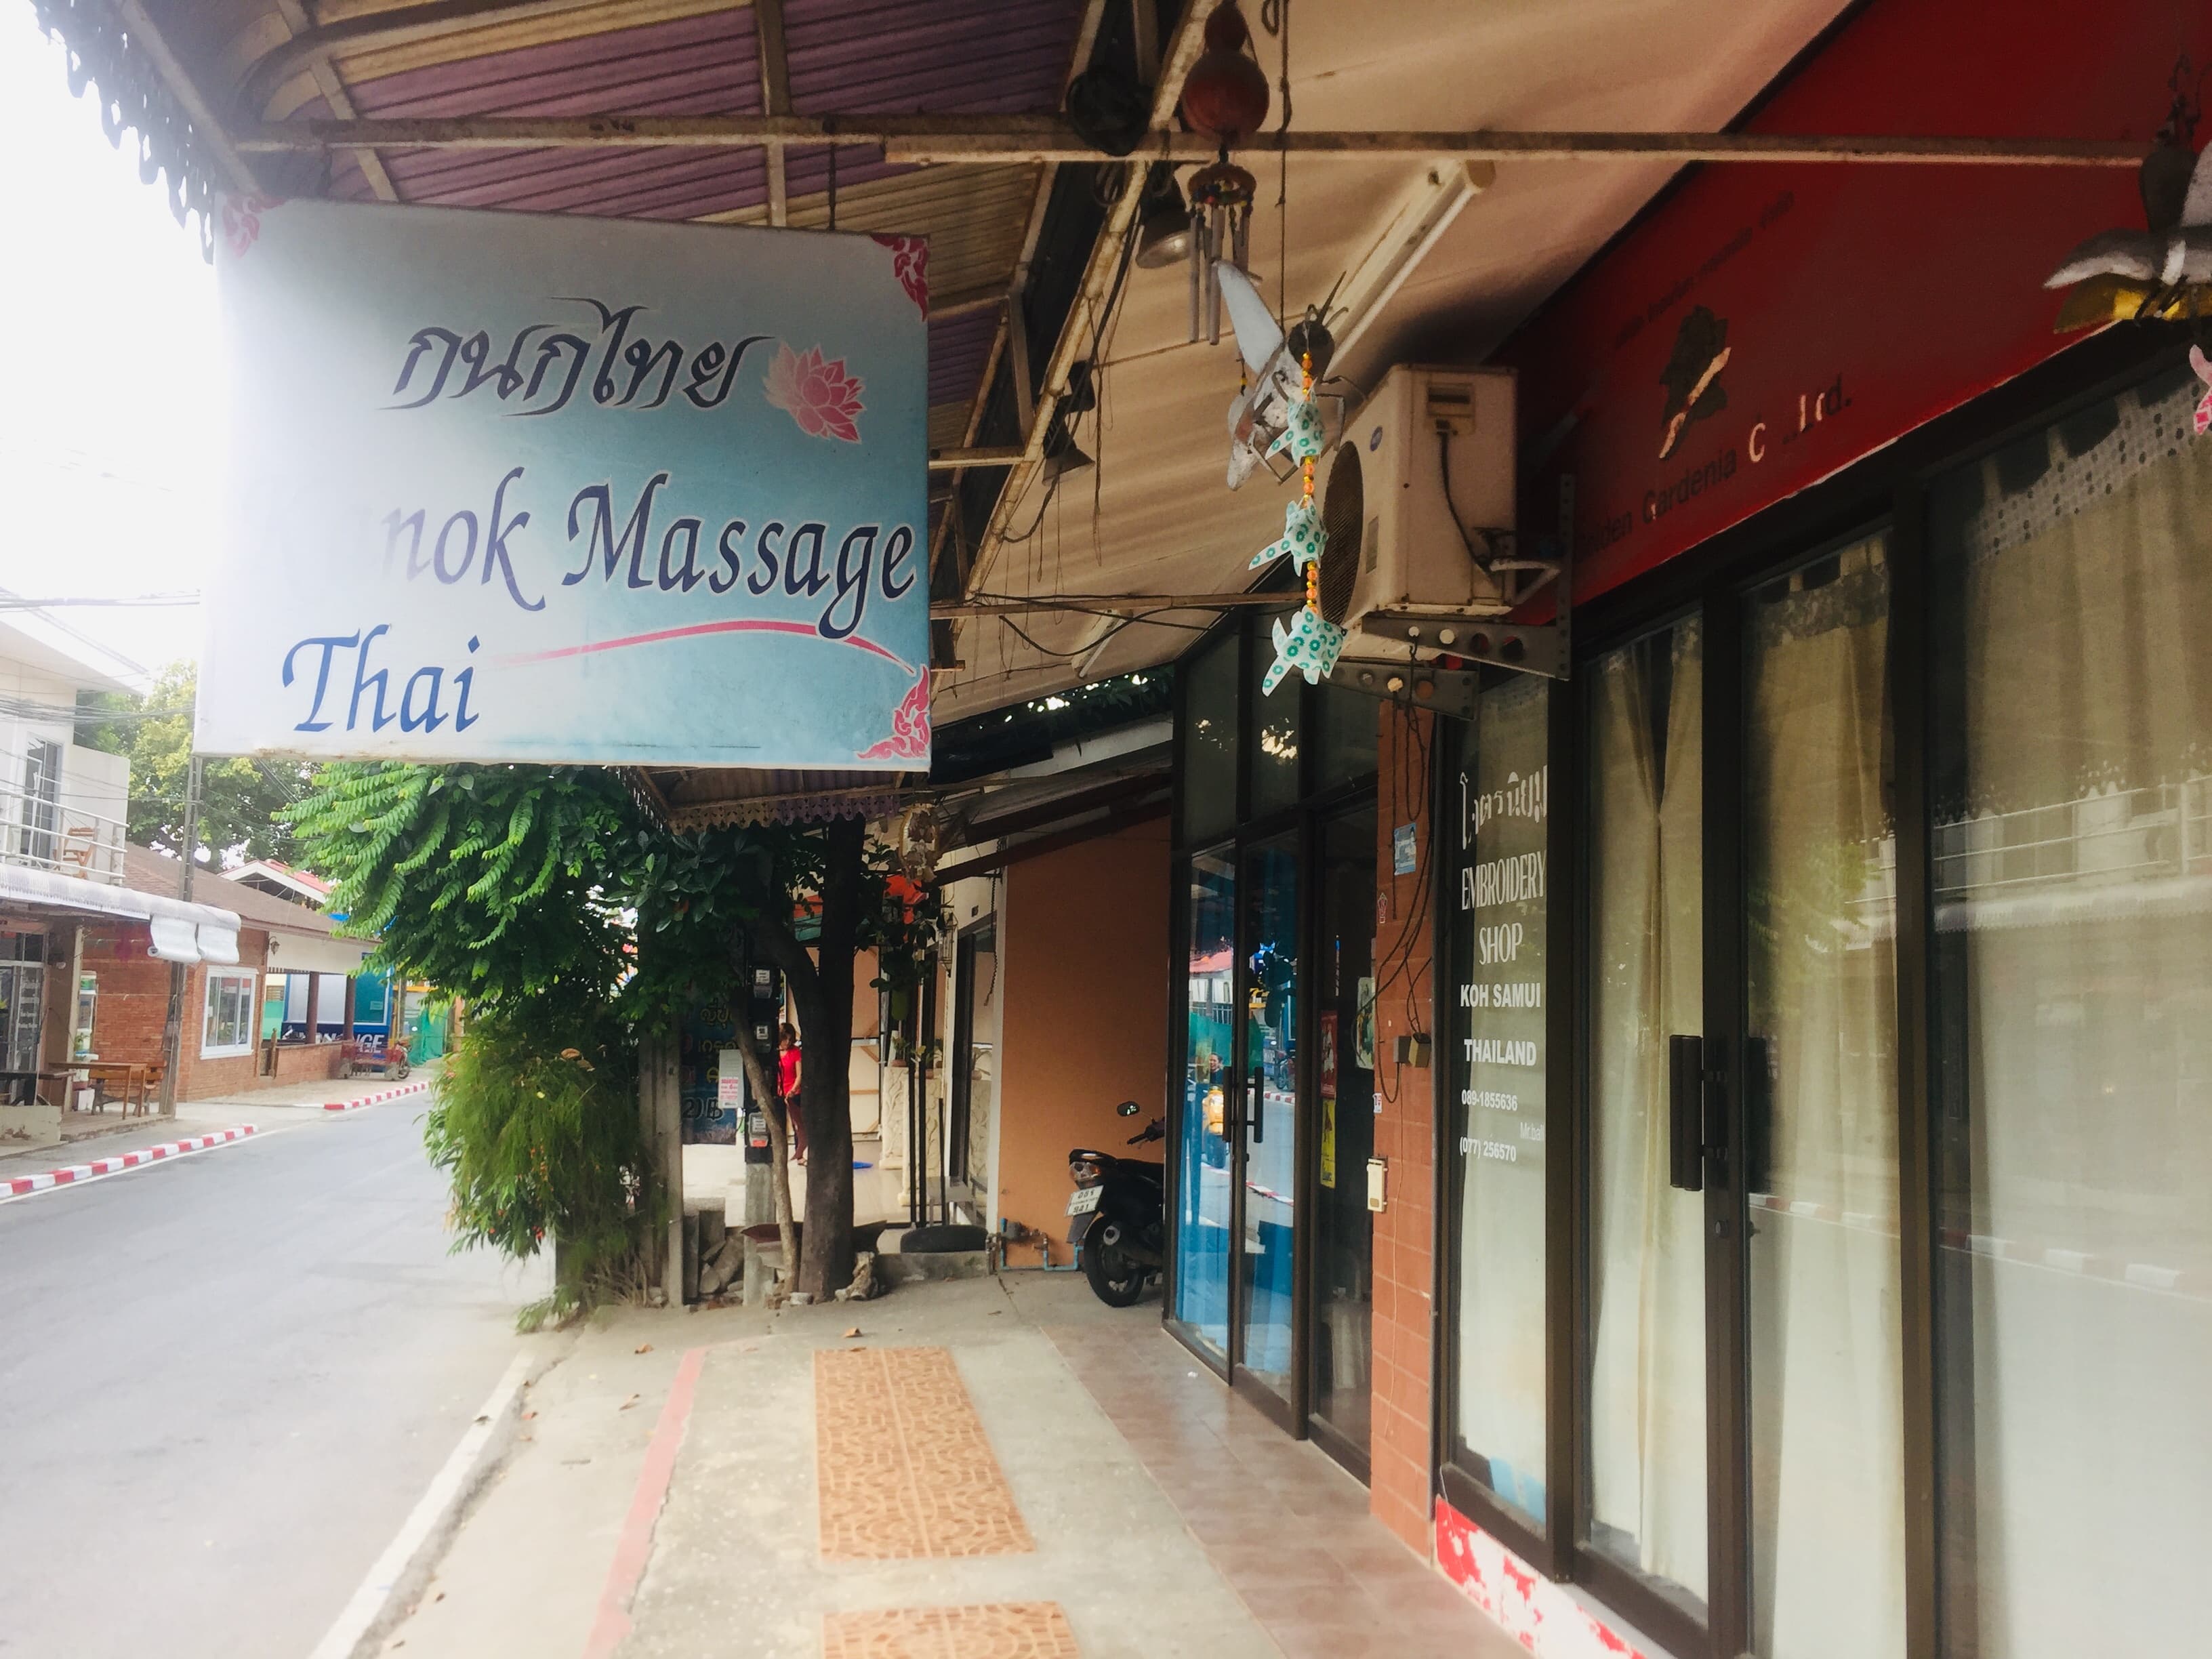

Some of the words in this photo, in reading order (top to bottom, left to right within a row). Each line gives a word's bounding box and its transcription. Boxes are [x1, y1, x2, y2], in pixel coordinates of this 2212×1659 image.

[380, 298, 775, 416] กนกไทย
[342, 466, 546, 611] nok
[562, 472, 916, 638] Massage
[282, 623, 479, 733] Thai
[1462, 851, 1547, 910] EMBROIDERY
[1479, 922, 1523, 965] SHOP
[1460, 984, 1489, 1008] KOH
[1493, 983, 1540, 1008] SAMUI
[1465, 1039, 1537, 1066] THAILAND
[1461, 1089, 1518, 1111] 089-1855636
[1460, 1136, 1481, 1159] (077)
[1483, 1141, 1517, 1162] 256570
